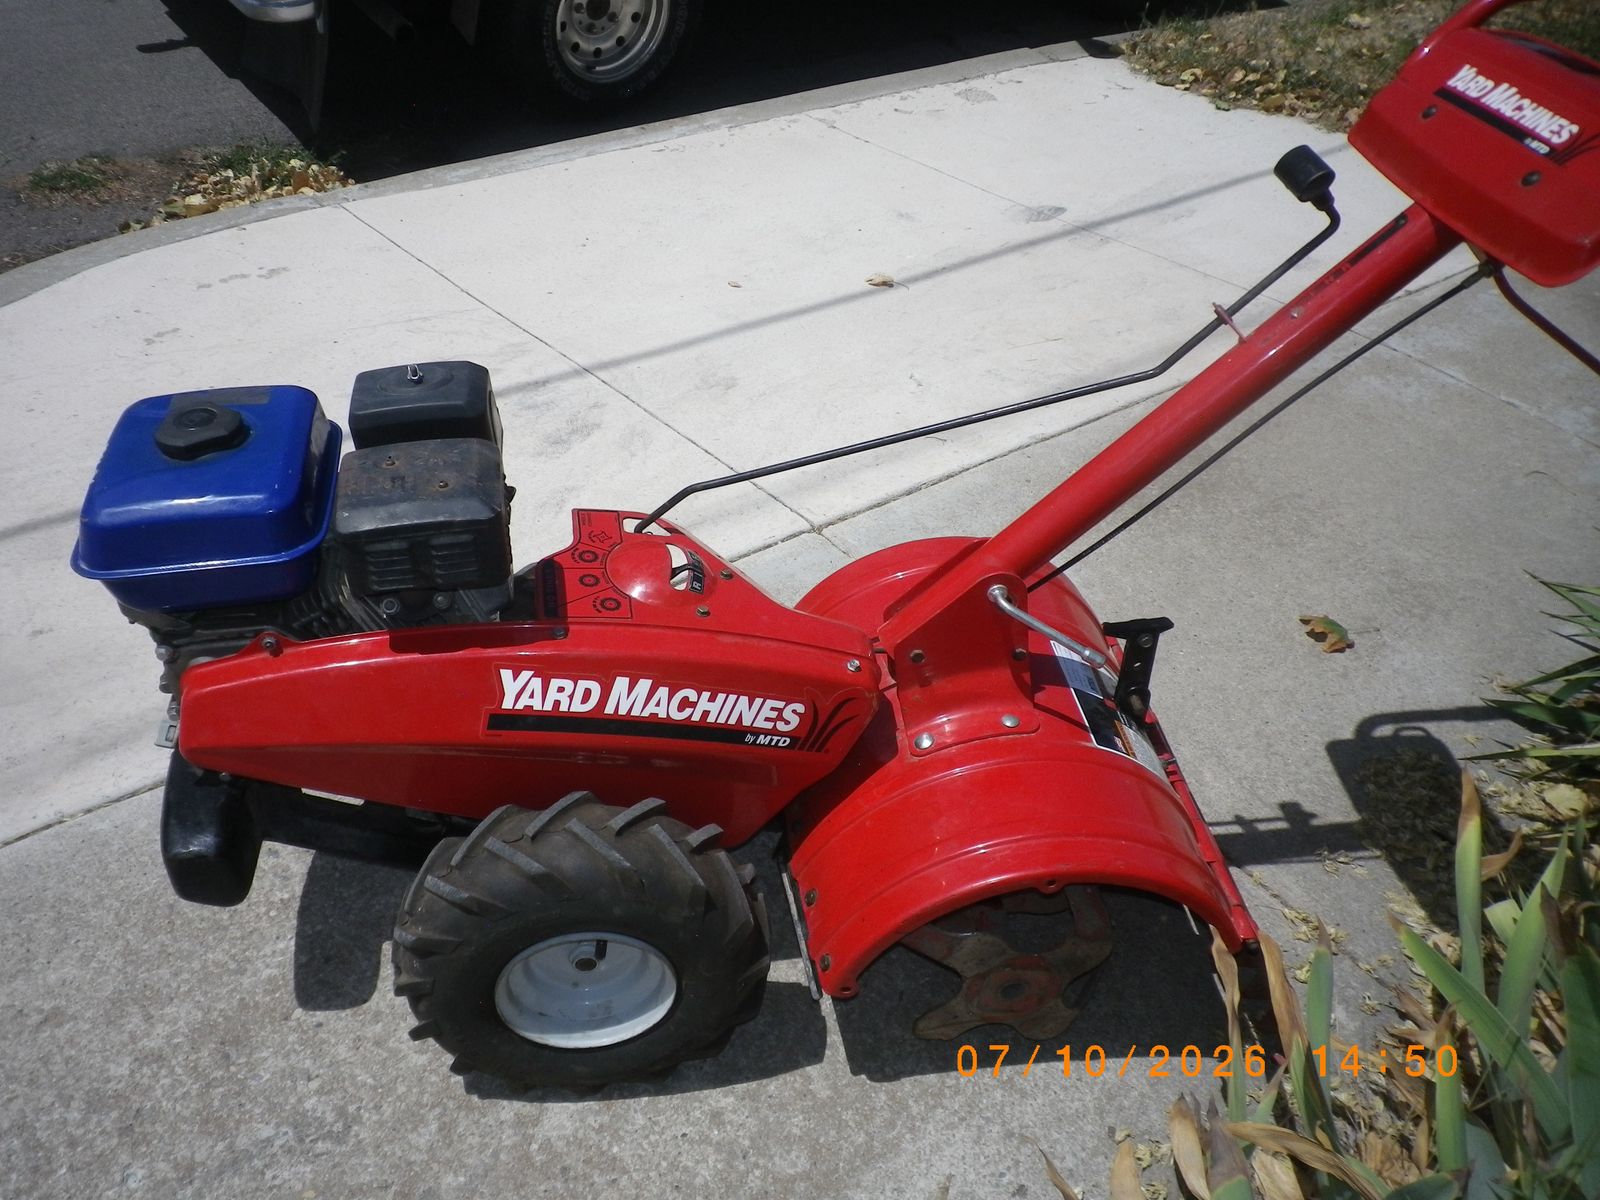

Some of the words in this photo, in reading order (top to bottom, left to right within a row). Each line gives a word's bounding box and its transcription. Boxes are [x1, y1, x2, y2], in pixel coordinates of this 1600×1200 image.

[1447, 64, 1495, 97] YARD
[1480, 82, 1580, 144] MACHINES
[499, 669, 601, 712] YARD
[604, 676, 805, 732] MACHINES
[744, 733, 755, 744] by
[756, 735, 791, 747] MTD
